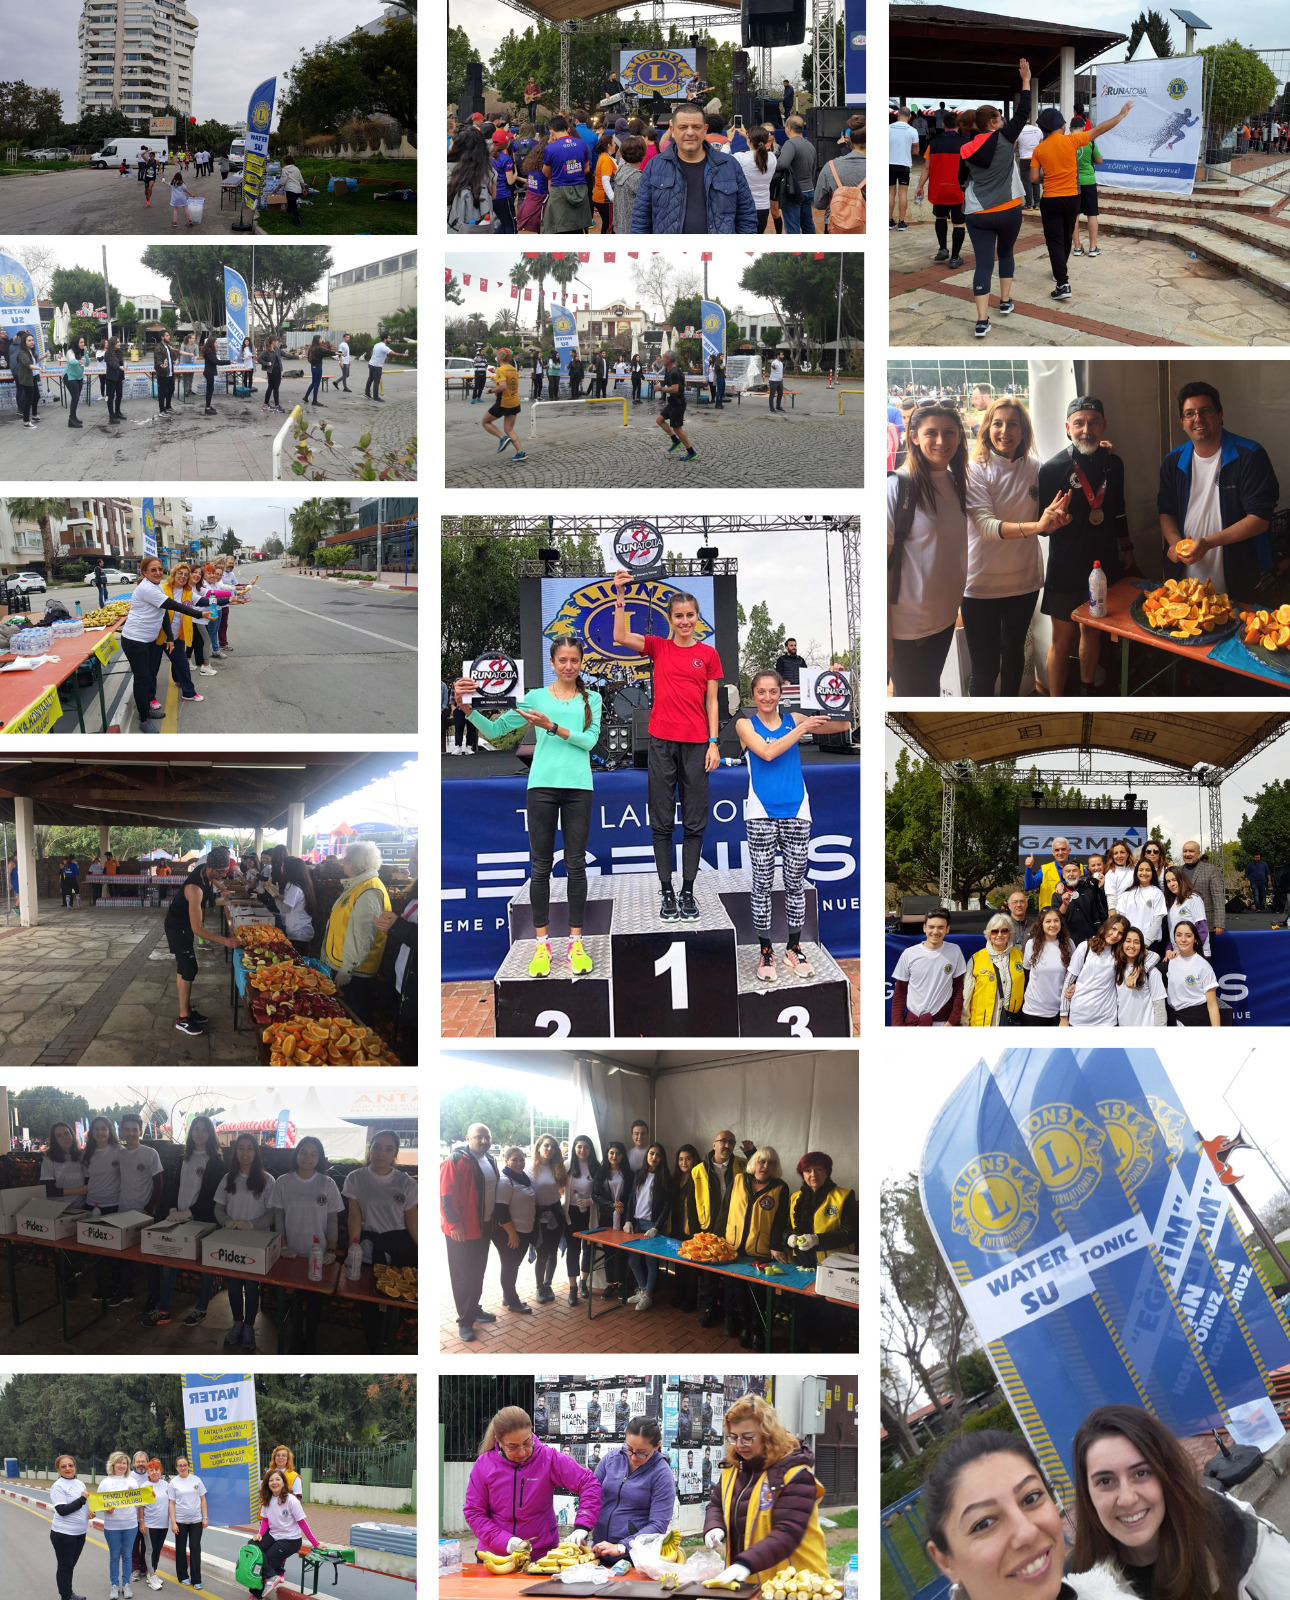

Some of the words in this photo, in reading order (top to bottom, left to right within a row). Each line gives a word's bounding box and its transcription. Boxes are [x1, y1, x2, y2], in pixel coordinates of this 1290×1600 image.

[636, 51, 679, 62] LIONS
[648, 64, 668, 81] L
[1107, 86, 1148, 96] RUNATOLIA
[615, 538, 663, 554] RUNATOLIA
[580, 582, 676, 604] LIONS
[471, 670, 518, 680] RUNATOLIA
[816, 685, 851, 696] RUNATOLIA
[27, 693, 55, 728] KONYAALTI
[654, 941, 689, 1010] 1
[534, 1010, 572, 1038] 2
[777, 1005, 814, 1038] 3
[1040, 1140, 1074, 1178] L
[956, 1156, 1004, 1193] LIONS
[978, 1186, 1013, 1221] L
[26, 1220, 44, 1232] Pidex
[88, 1226, 108, 1240] Pidex
[983, 1215, 1033, 1247] INTERNATIONAL
[218, 1248, 246, 1264] Pidex
[986, 1245, 1070, 1297] WATER
[1020, 1281, 1060, 1316] SU
[103, 1500, 120, 1508] LIONS
